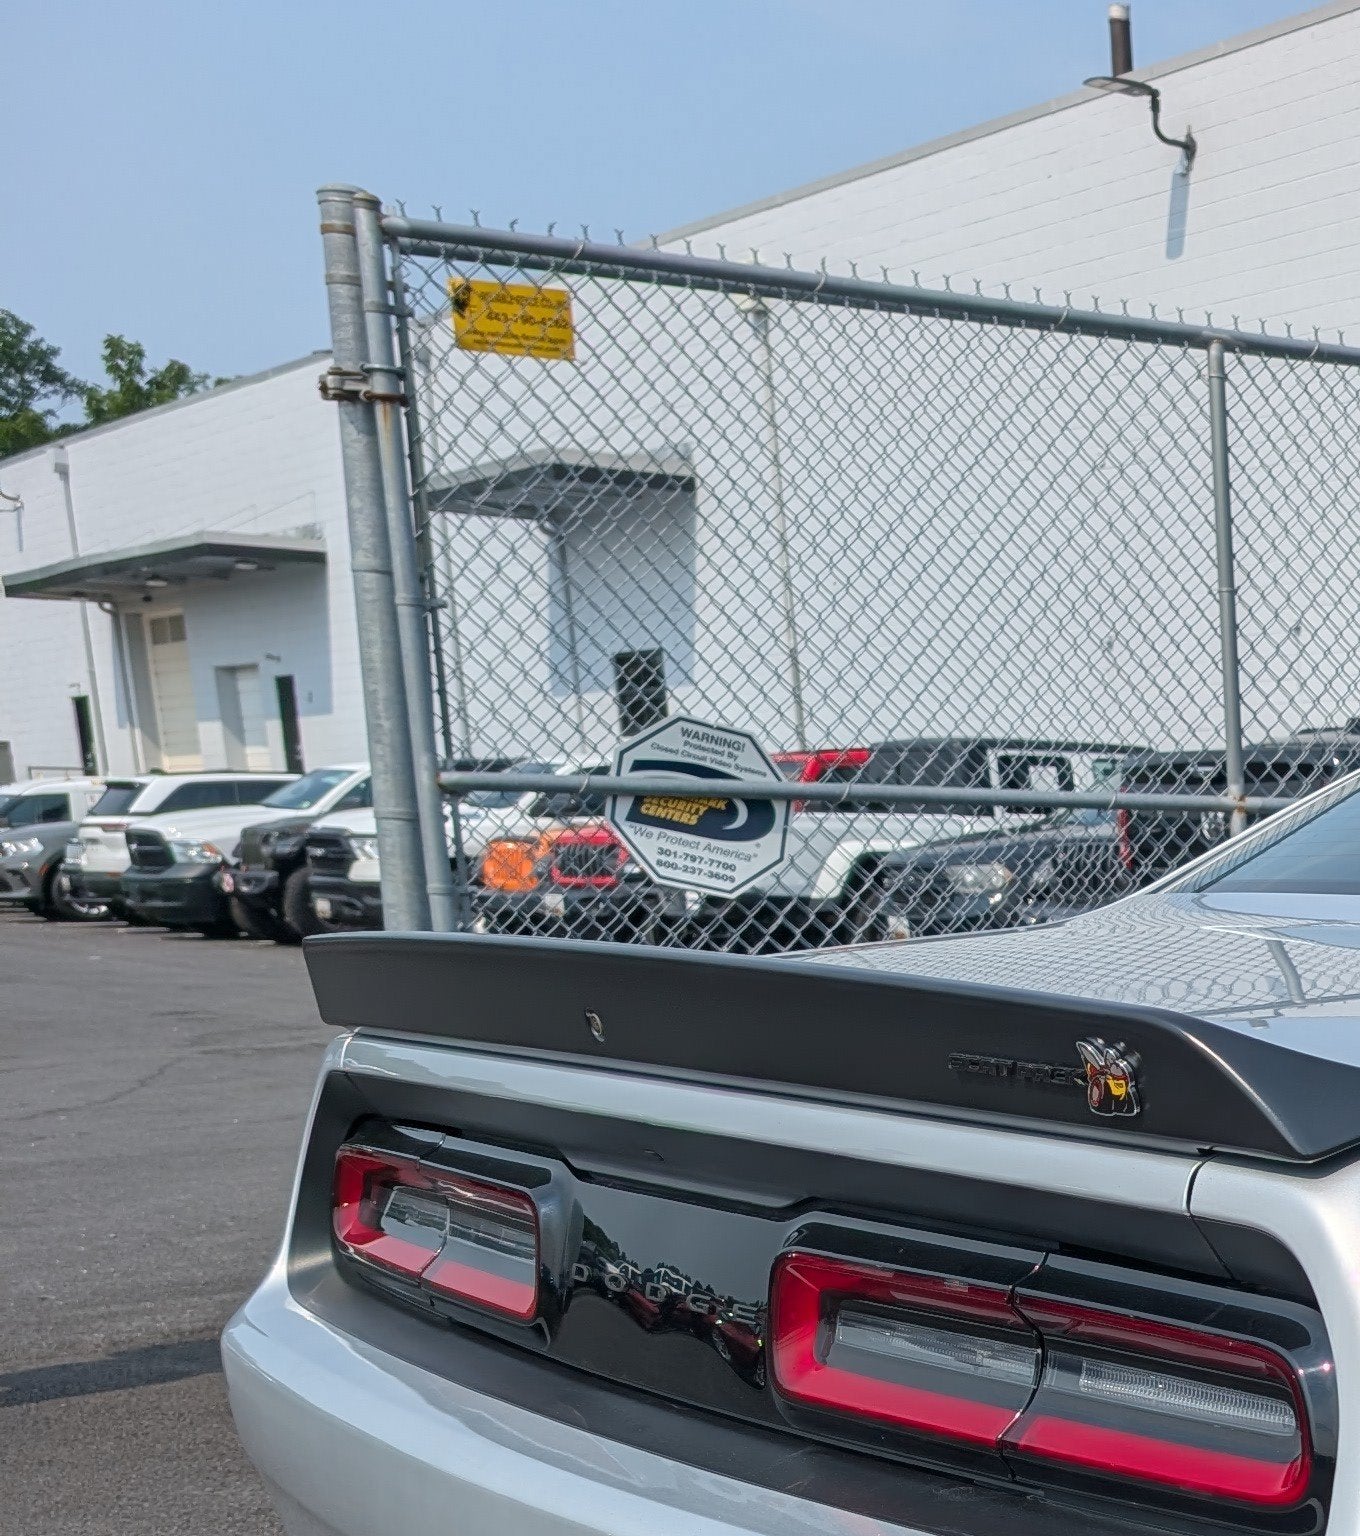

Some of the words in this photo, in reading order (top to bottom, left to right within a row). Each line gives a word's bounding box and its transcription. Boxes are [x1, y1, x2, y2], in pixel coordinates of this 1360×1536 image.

[681, 727, 746, 753] WARNING!
[683, 740, 725, 757] Protected
[727, 751, 739, 761] By
[650, 742, 680, 755] Closed
[680, 750, 708, 762] Circuit
[710, 757, 732, 768] Video
[734, 763, 767, 778] Systems
[640, 803, 699, 826] CENTERS
[657, 831, 700, 850] Protect
[656, 859, 736, 883] 800-237-3609
[657, 847, 737, 872] 301-797-7700
[572, 1262, 759, 1325] DODGE
